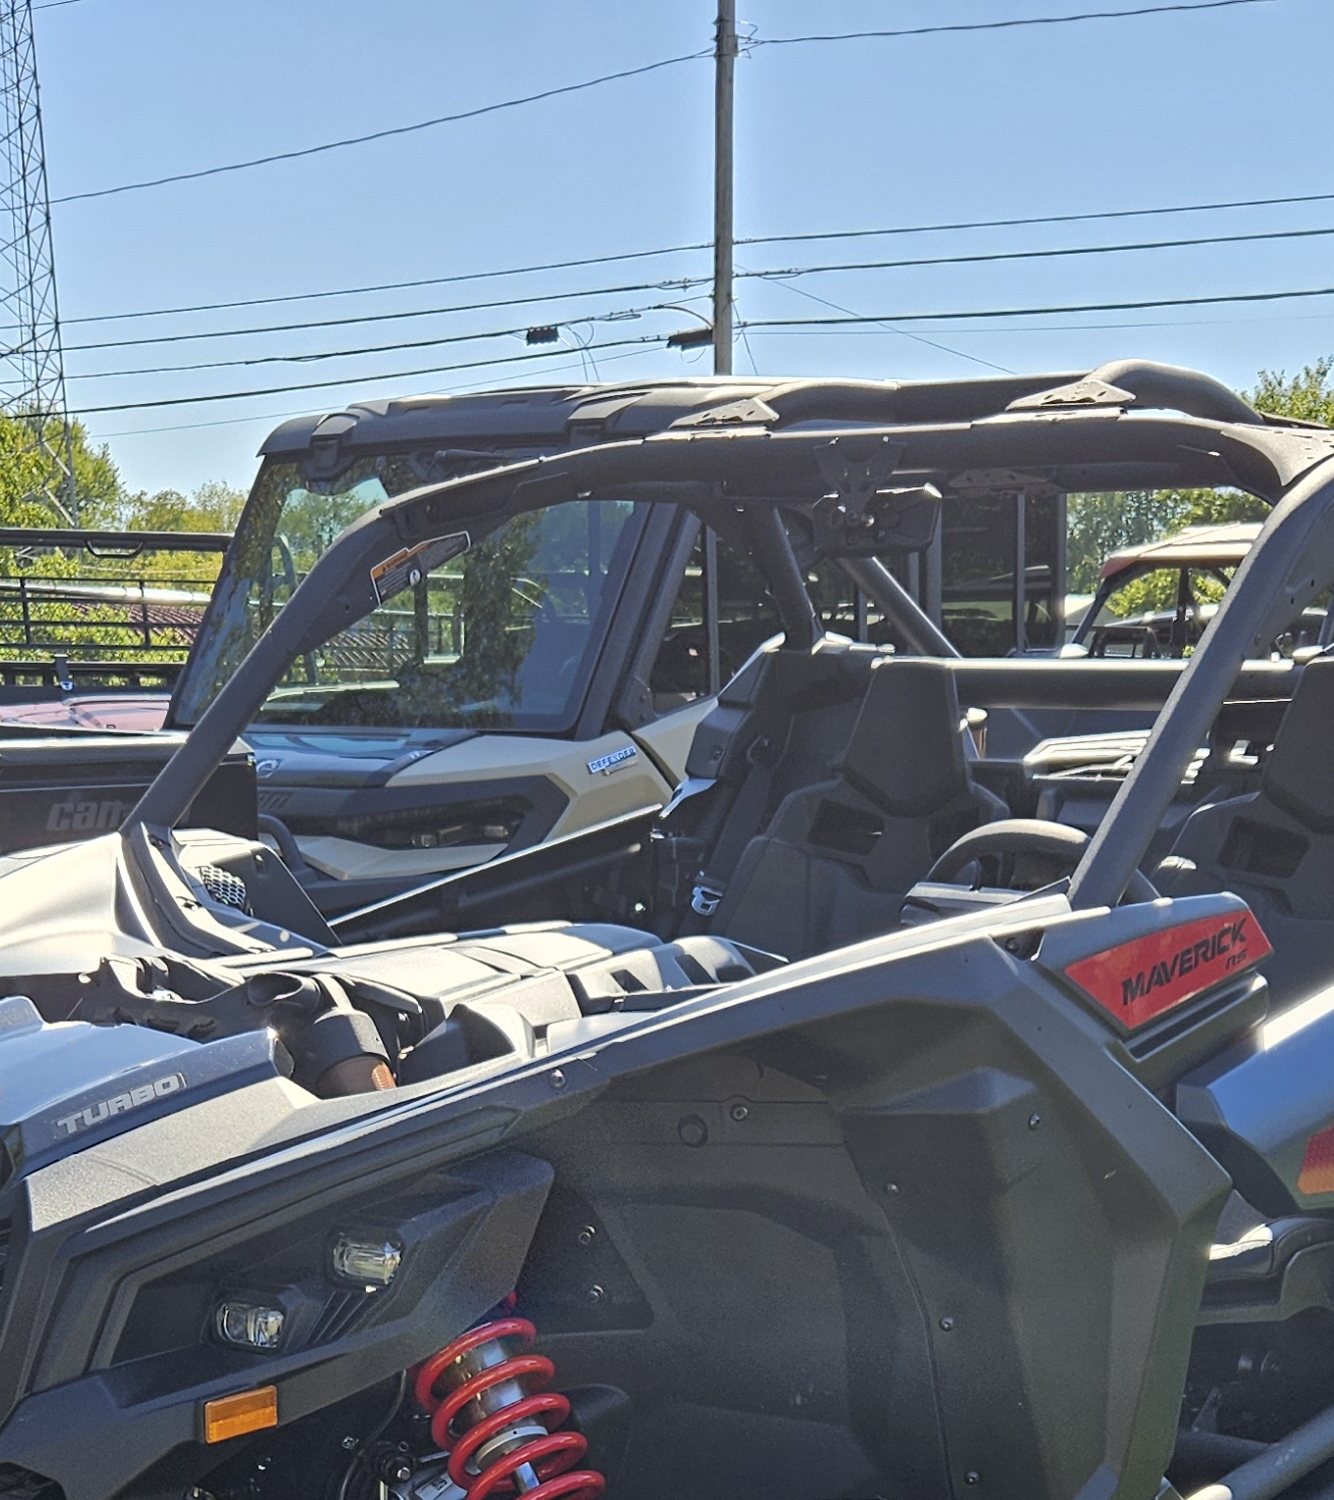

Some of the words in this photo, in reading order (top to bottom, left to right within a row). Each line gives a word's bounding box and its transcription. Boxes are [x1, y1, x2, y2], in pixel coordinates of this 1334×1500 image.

[589, 746, 636, 771] DEFENDER
[1121, 917, 1247, 1006] MAVERICK
[57, 1074, 180, 1134] TURBO
